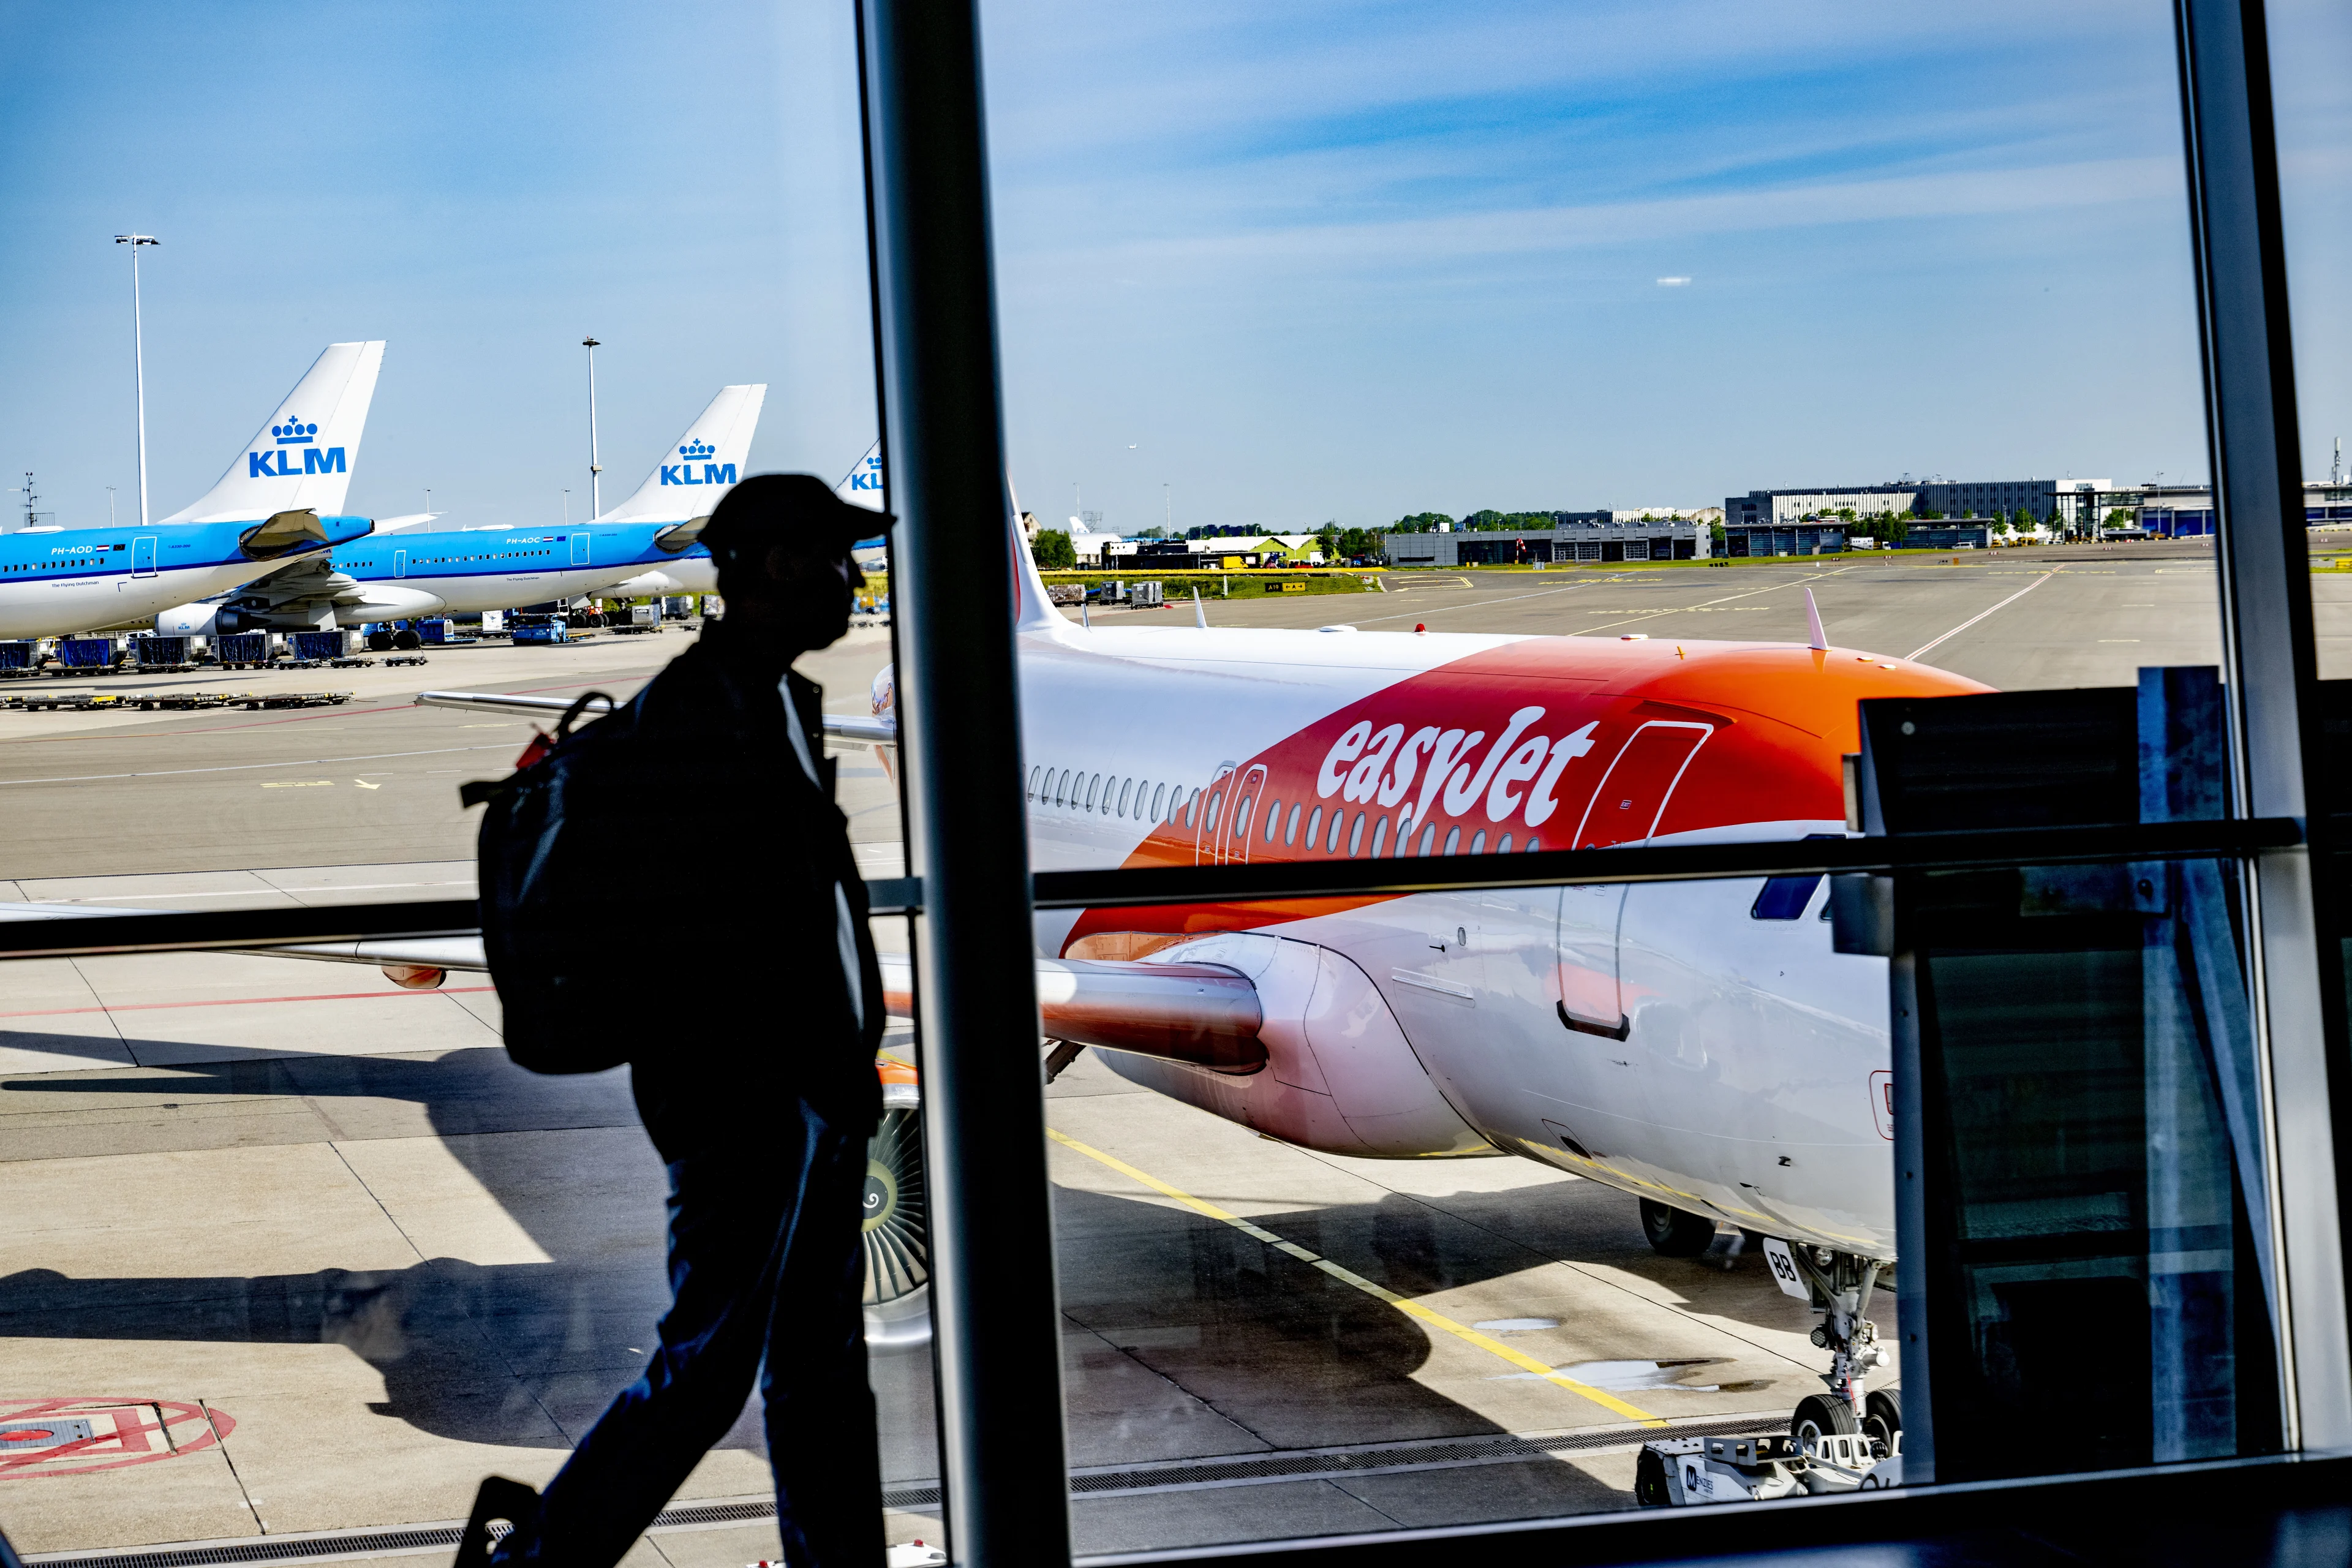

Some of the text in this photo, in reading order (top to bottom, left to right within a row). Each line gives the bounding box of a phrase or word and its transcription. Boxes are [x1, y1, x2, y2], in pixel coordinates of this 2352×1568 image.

[249, 447, 346, 477] KLM
[660, 463, 736, 486] KLM
[852, 472, 884, 491] KL
[51, 546, 92, 555] PH-AOD
[1317, 706, 1600, 836] easyJet
[1769, 1251, 1796, 1282] BB
[1687, 1469, 1713, 1490] MENZIES
